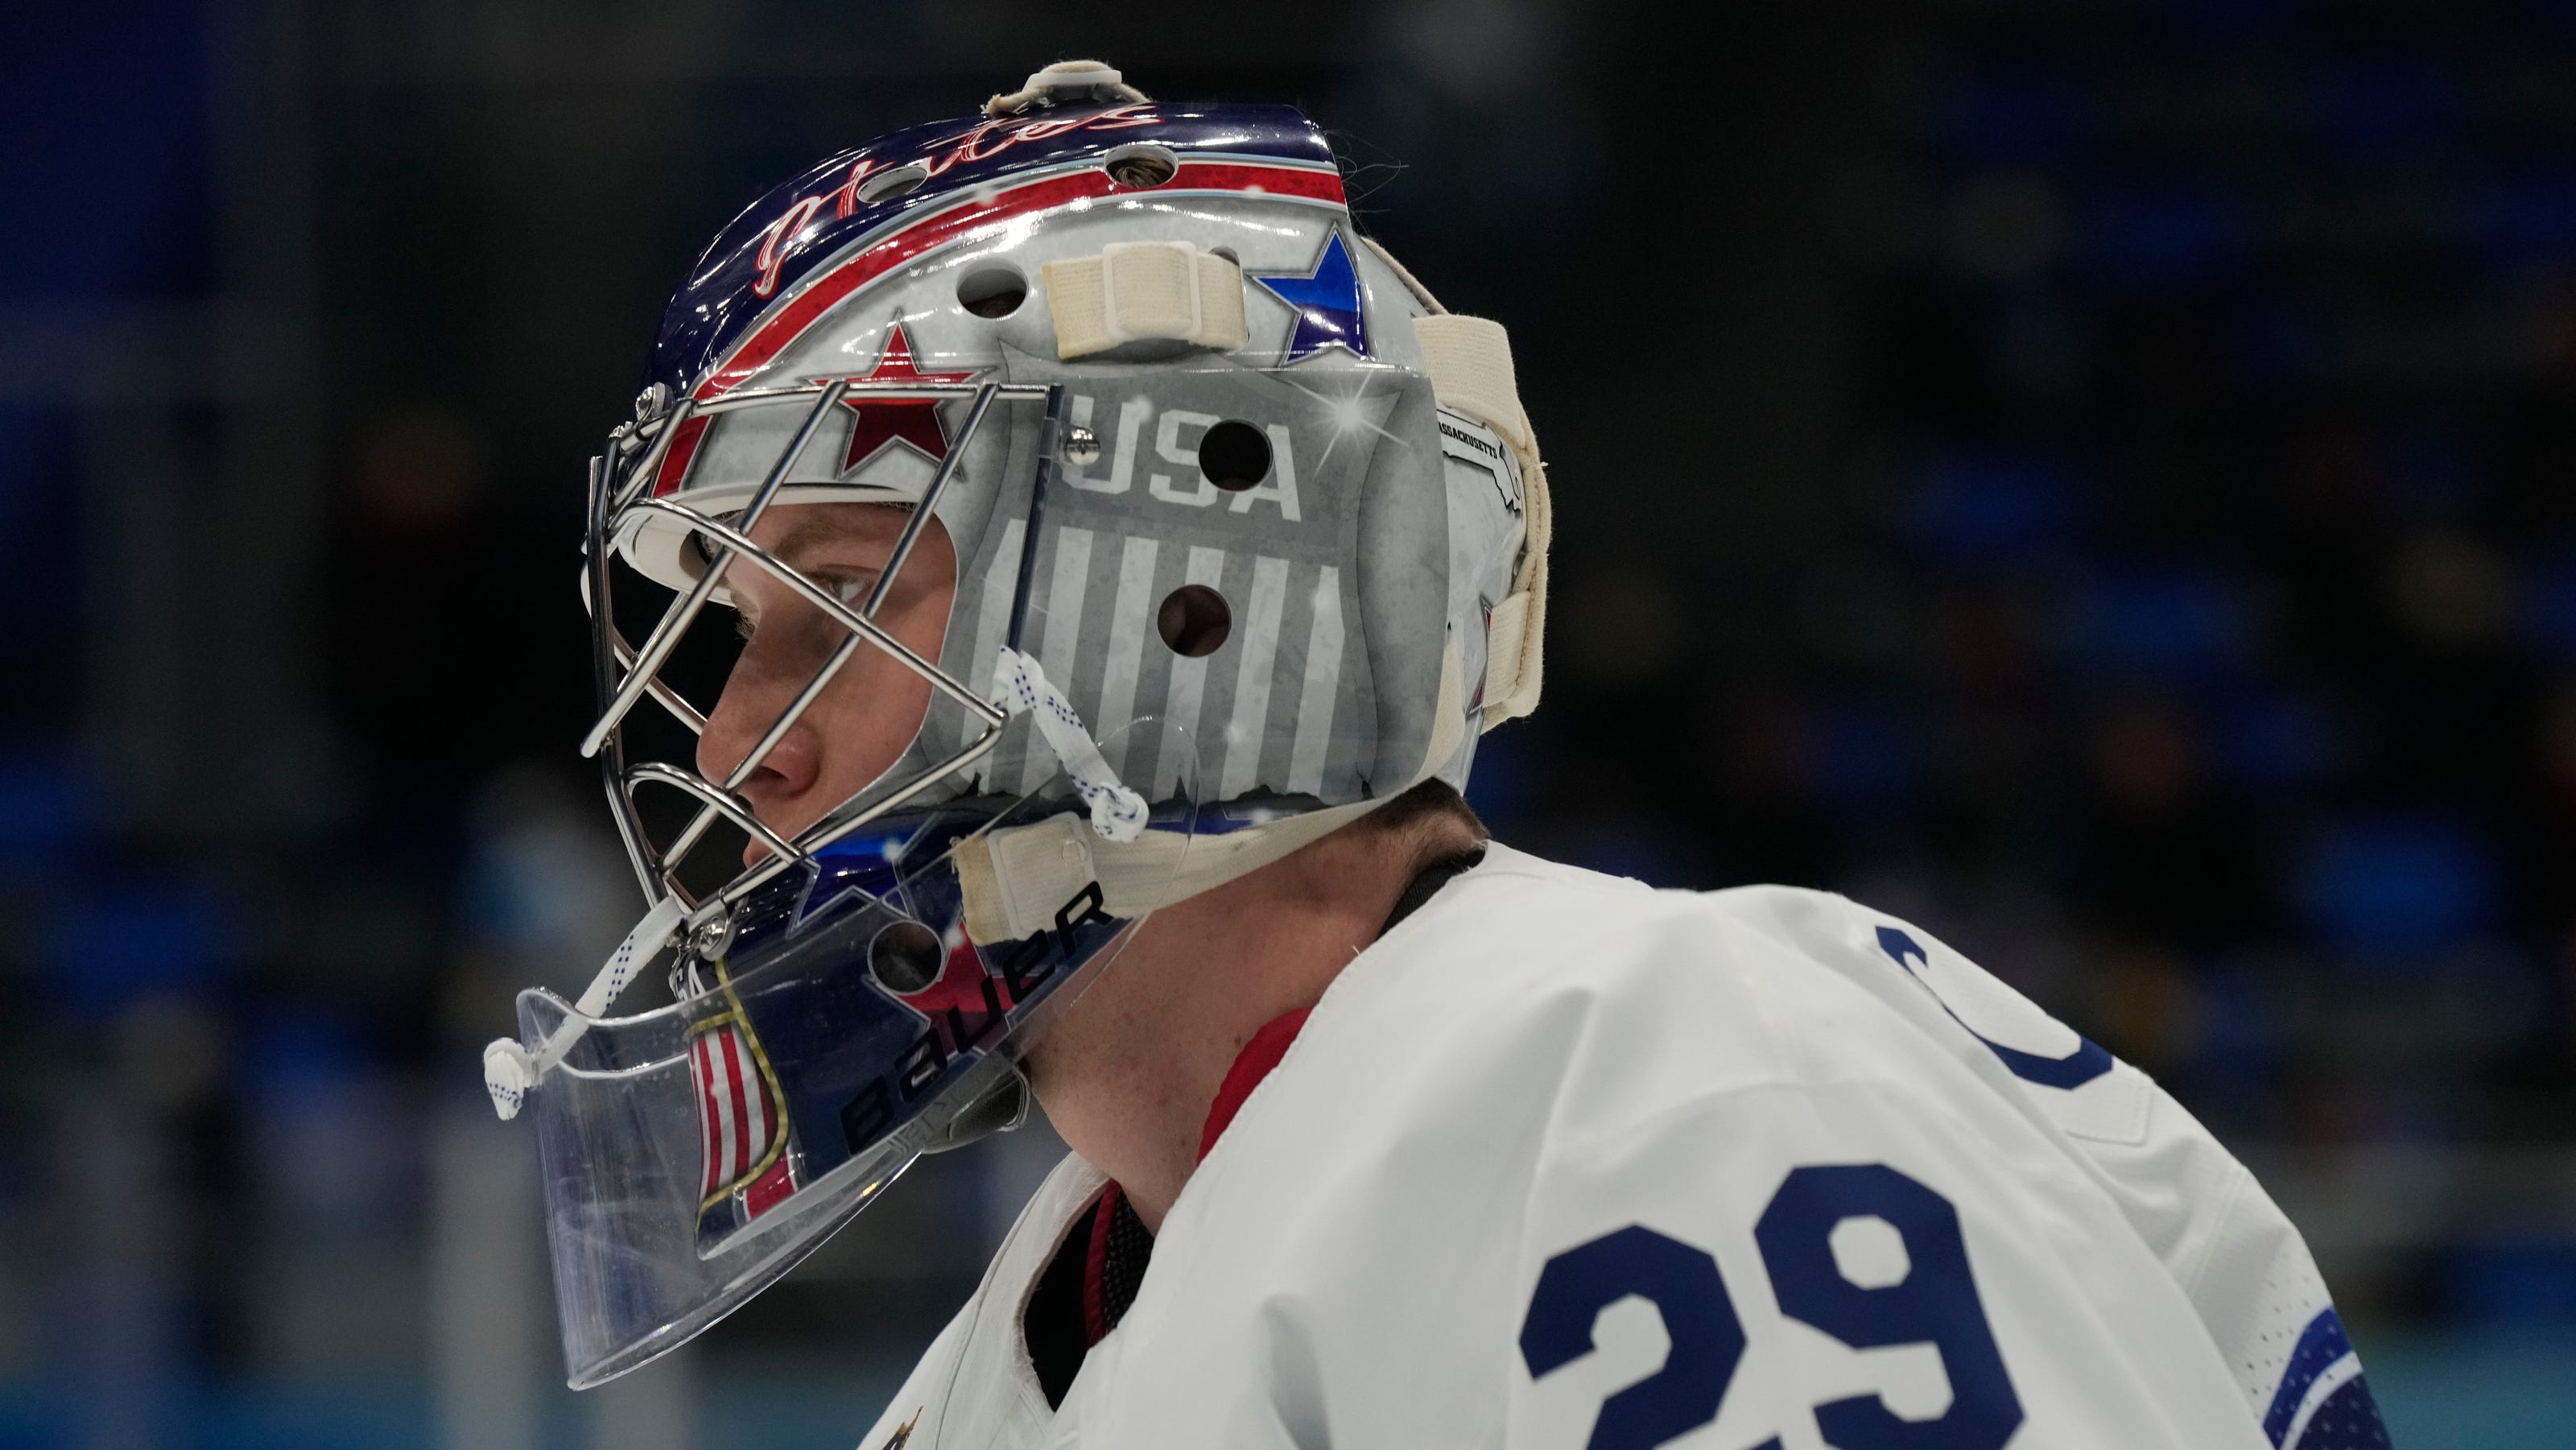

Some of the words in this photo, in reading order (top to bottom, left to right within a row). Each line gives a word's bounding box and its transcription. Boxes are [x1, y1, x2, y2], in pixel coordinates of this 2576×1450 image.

[752, 105, 1165, 299] Sttes
[1062, 394, 1302, 523] USA
[1438, 421, 1497, 460] ASSACHUSETTS
[1519, 1162, 2026, 1450] 29
